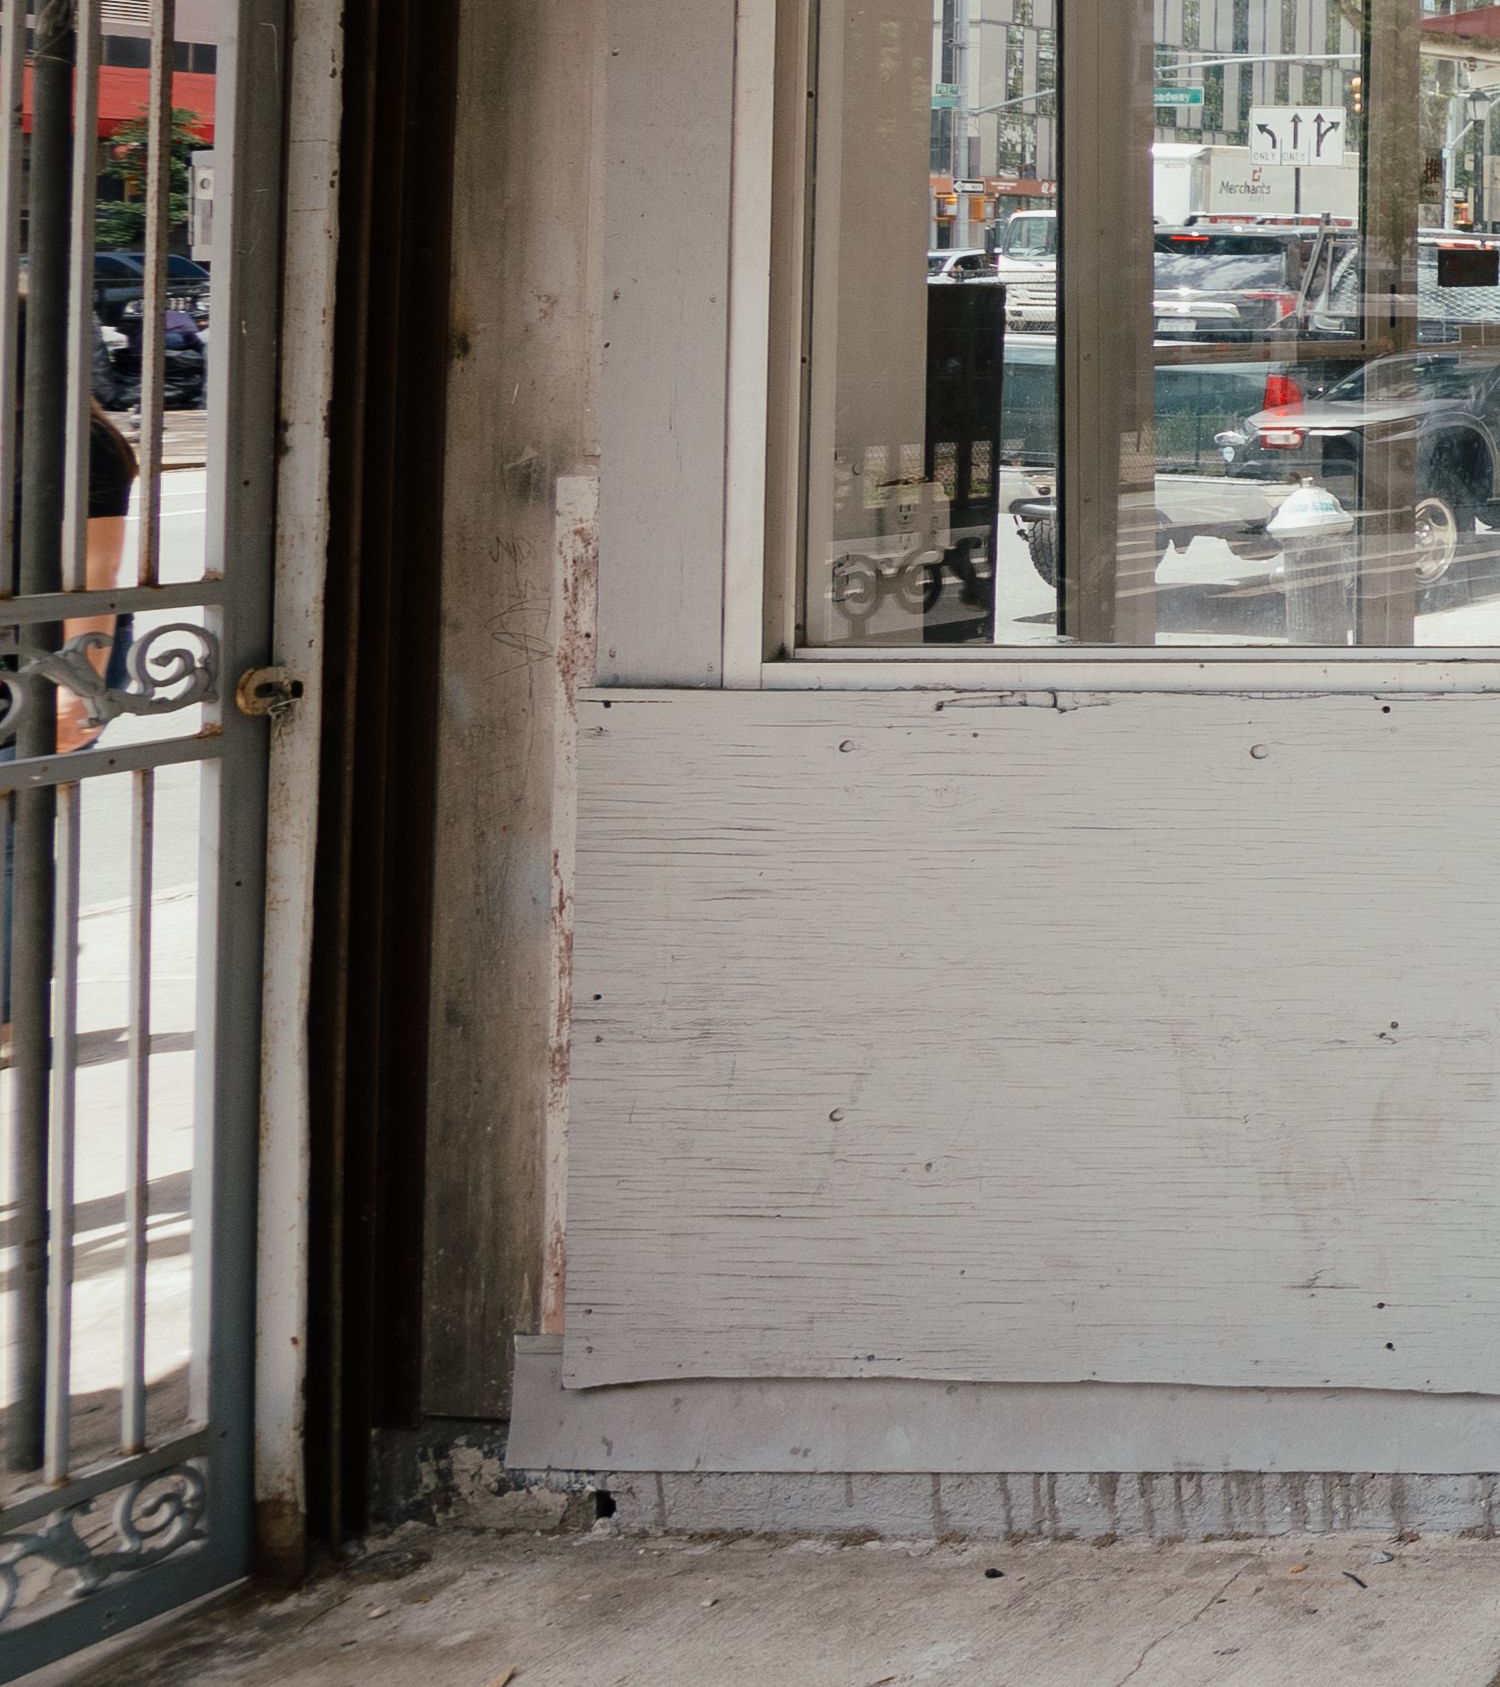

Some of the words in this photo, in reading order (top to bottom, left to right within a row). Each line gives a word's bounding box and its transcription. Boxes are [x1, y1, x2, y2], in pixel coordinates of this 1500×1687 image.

[1154, 93, 1190, 103] oadway
[1254, 153, 1275, 161] ONLY
[1219, 181, 1271, 195] Merchants
